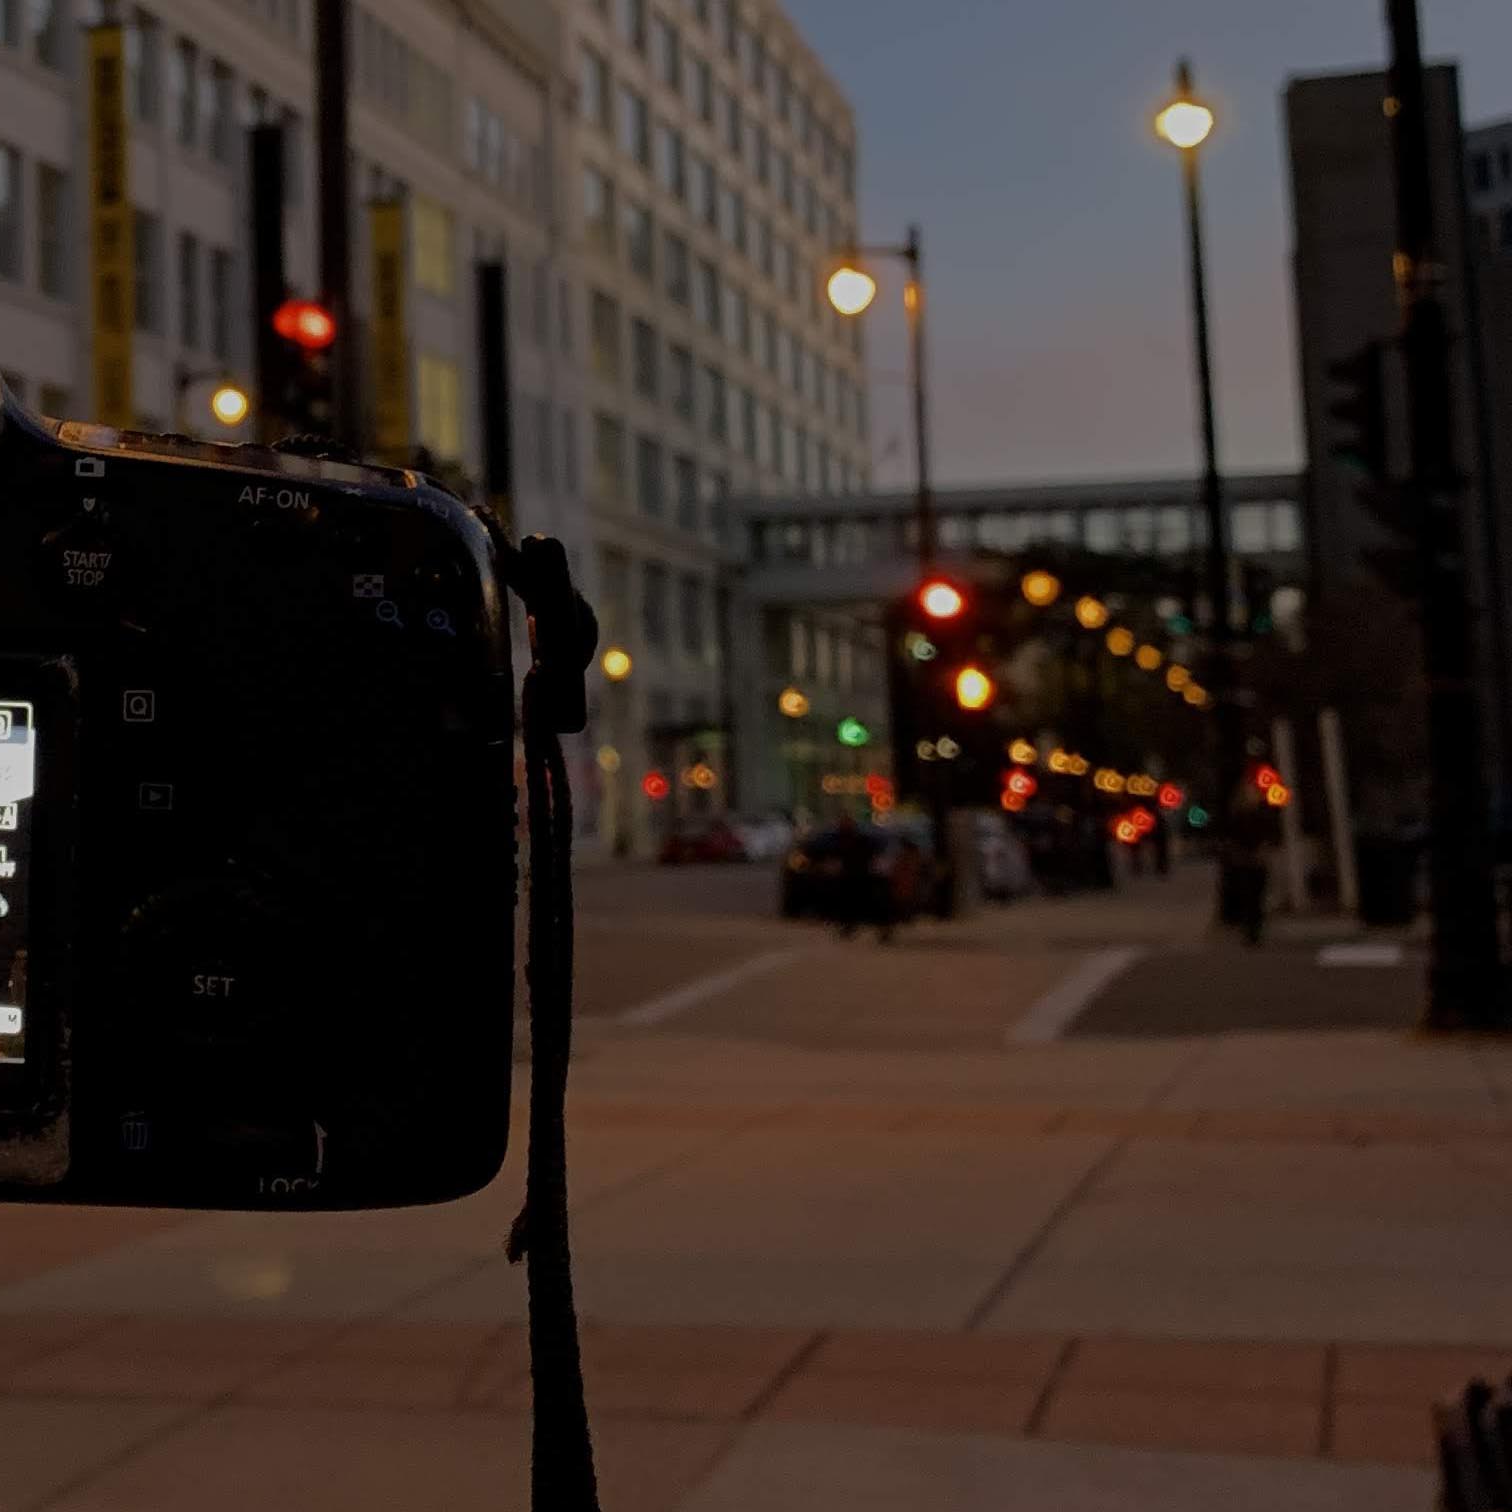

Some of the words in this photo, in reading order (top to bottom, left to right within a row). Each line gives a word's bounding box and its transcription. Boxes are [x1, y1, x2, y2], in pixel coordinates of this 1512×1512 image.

[238, 485, 311, 510] AF-ON
[66, 568, 106, 586] STOP
[192, 973, 236, 998] SET
